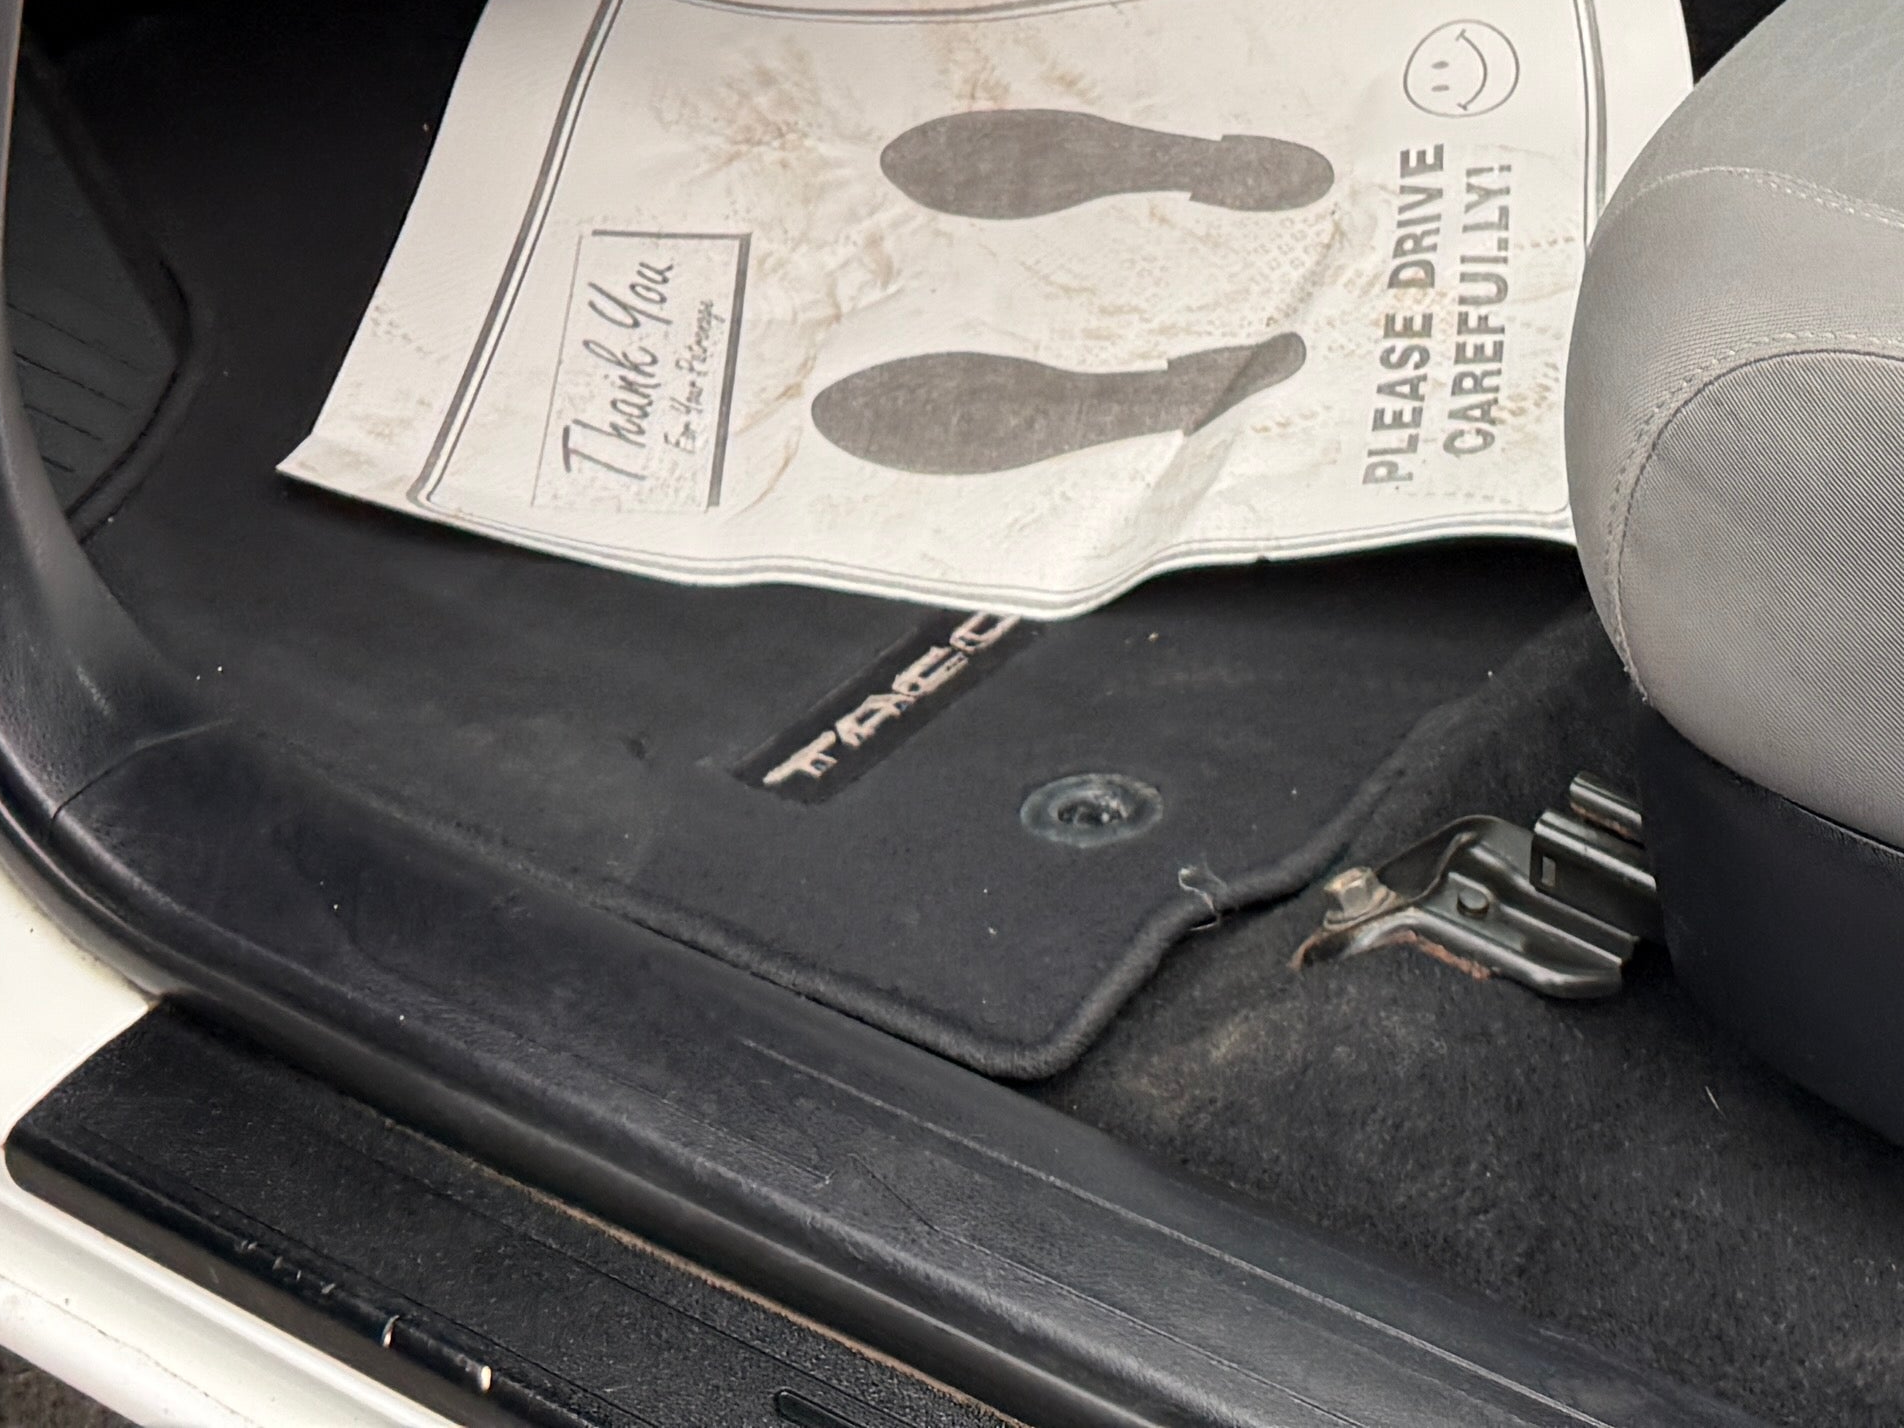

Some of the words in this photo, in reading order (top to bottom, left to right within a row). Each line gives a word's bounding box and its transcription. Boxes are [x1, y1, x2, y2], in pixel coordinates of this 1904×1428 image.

[1387, 142, 1445, 290] DRIVE
[586, 260, 675, 330] You
[1442, 162, 1513, 459] CAREFULLY!
[561, 337, 662, 482] Thank
[1362, 312, 1433, 487] PLEASE
